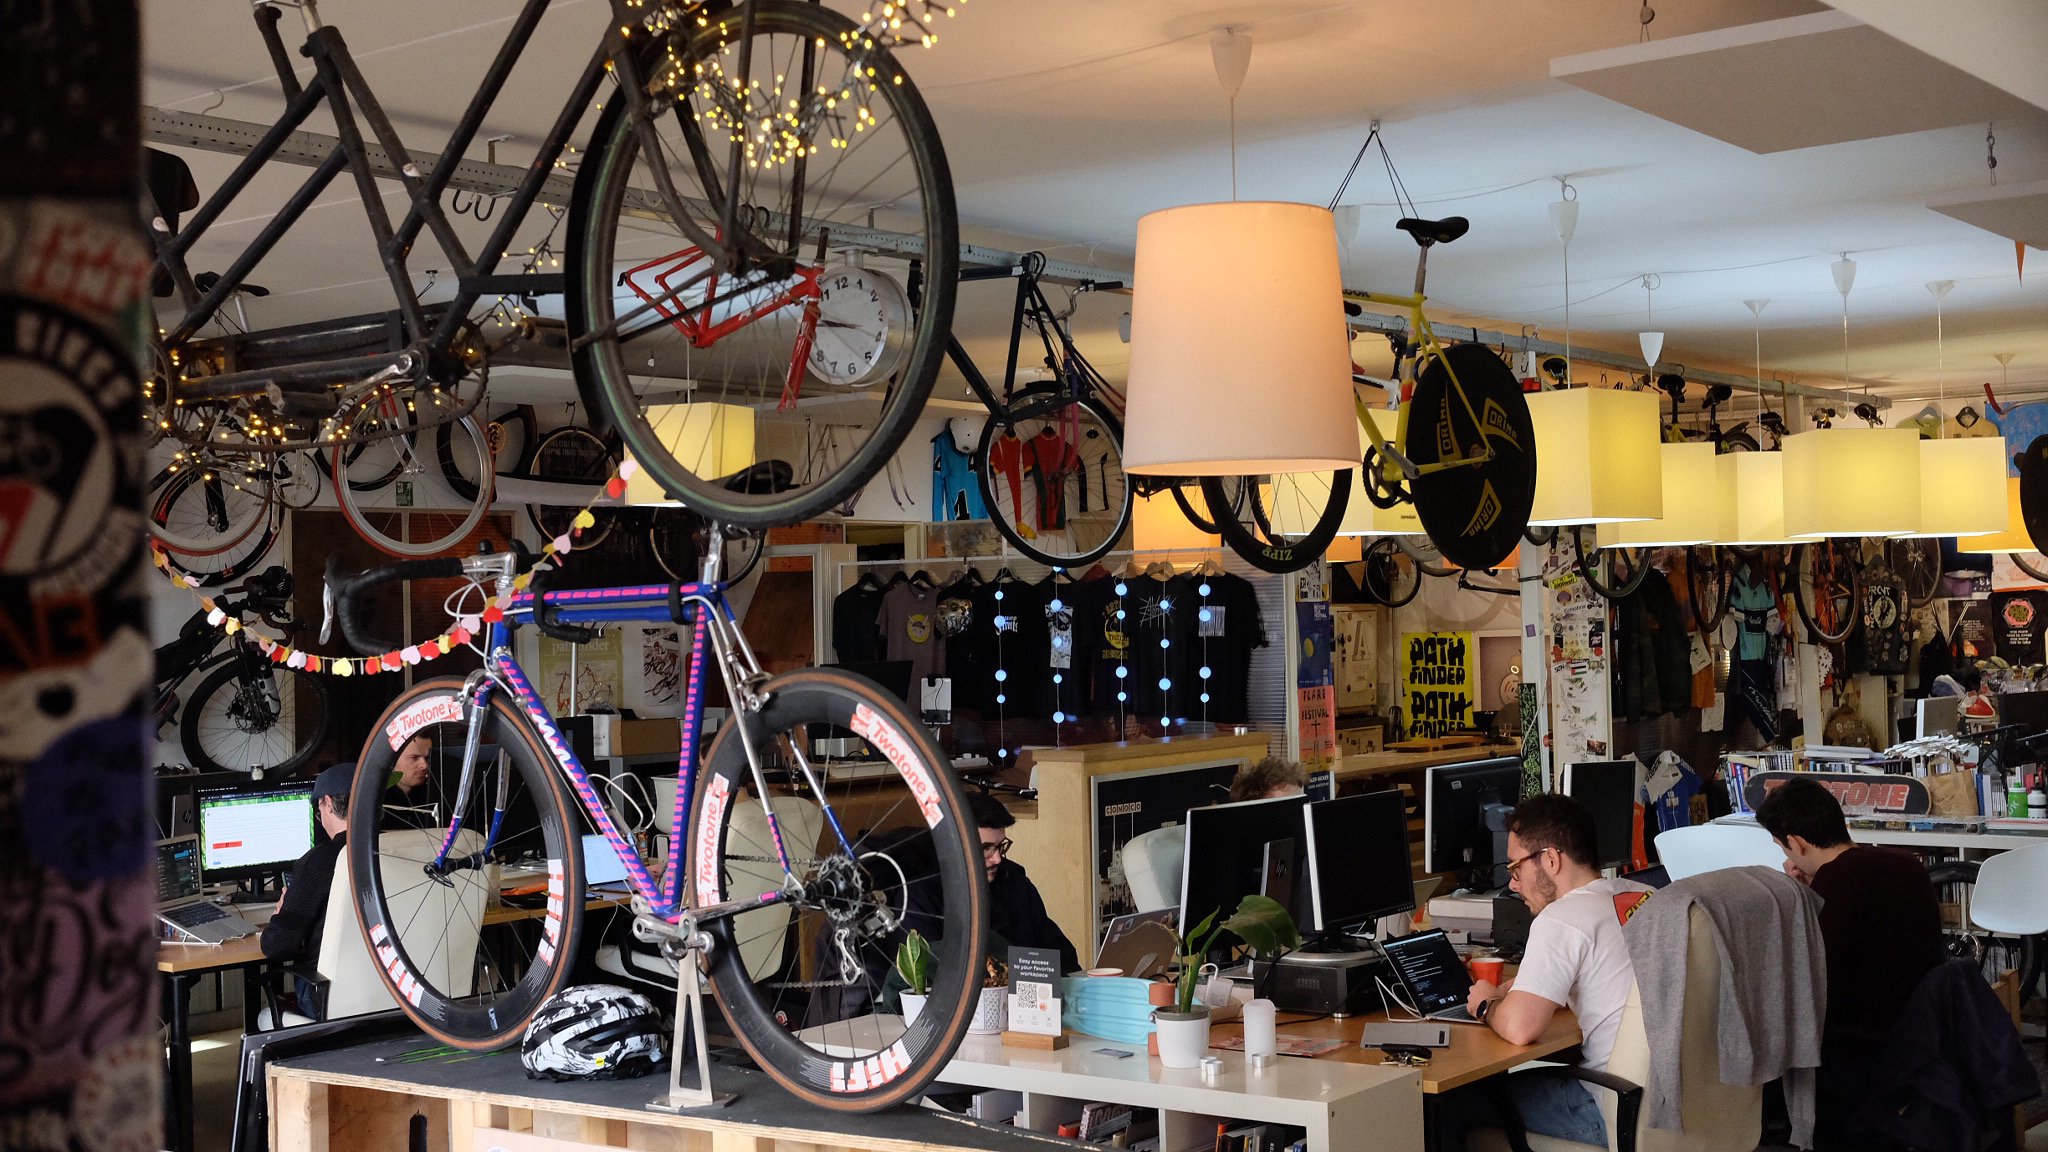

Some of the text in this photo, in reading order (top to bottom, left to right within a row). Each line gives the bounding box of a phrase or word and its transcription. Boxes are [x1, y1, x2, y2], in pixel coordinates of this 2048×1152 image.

[834, 276, 848, 290] 12
[870, 290, 878, 302] 2
[816, 350, 825, 362] 8
[864, 351, 872, 364] 5
[830, 361, 838, 374] 7
[847, 362, 856, 375] 6
[1262, 546, 1293, 561] ZIPP
[1410, 637, 1465, 666] PATH
[1411, 691, 1466, 721] PATH
[399, 703, 446, 732] Twotone
[874, 721, 926, 795] Twotone
[1764, 779, 1910, 810] TTONE
[1105, 802, 1141, 816] CONOCO
[700, 802, 718, 885] Twotone
[1018, 957, 1031, 966] Easy
[1020, 971, 1049, 979] workspace
[1033, 965, 1055, 973] favorite
